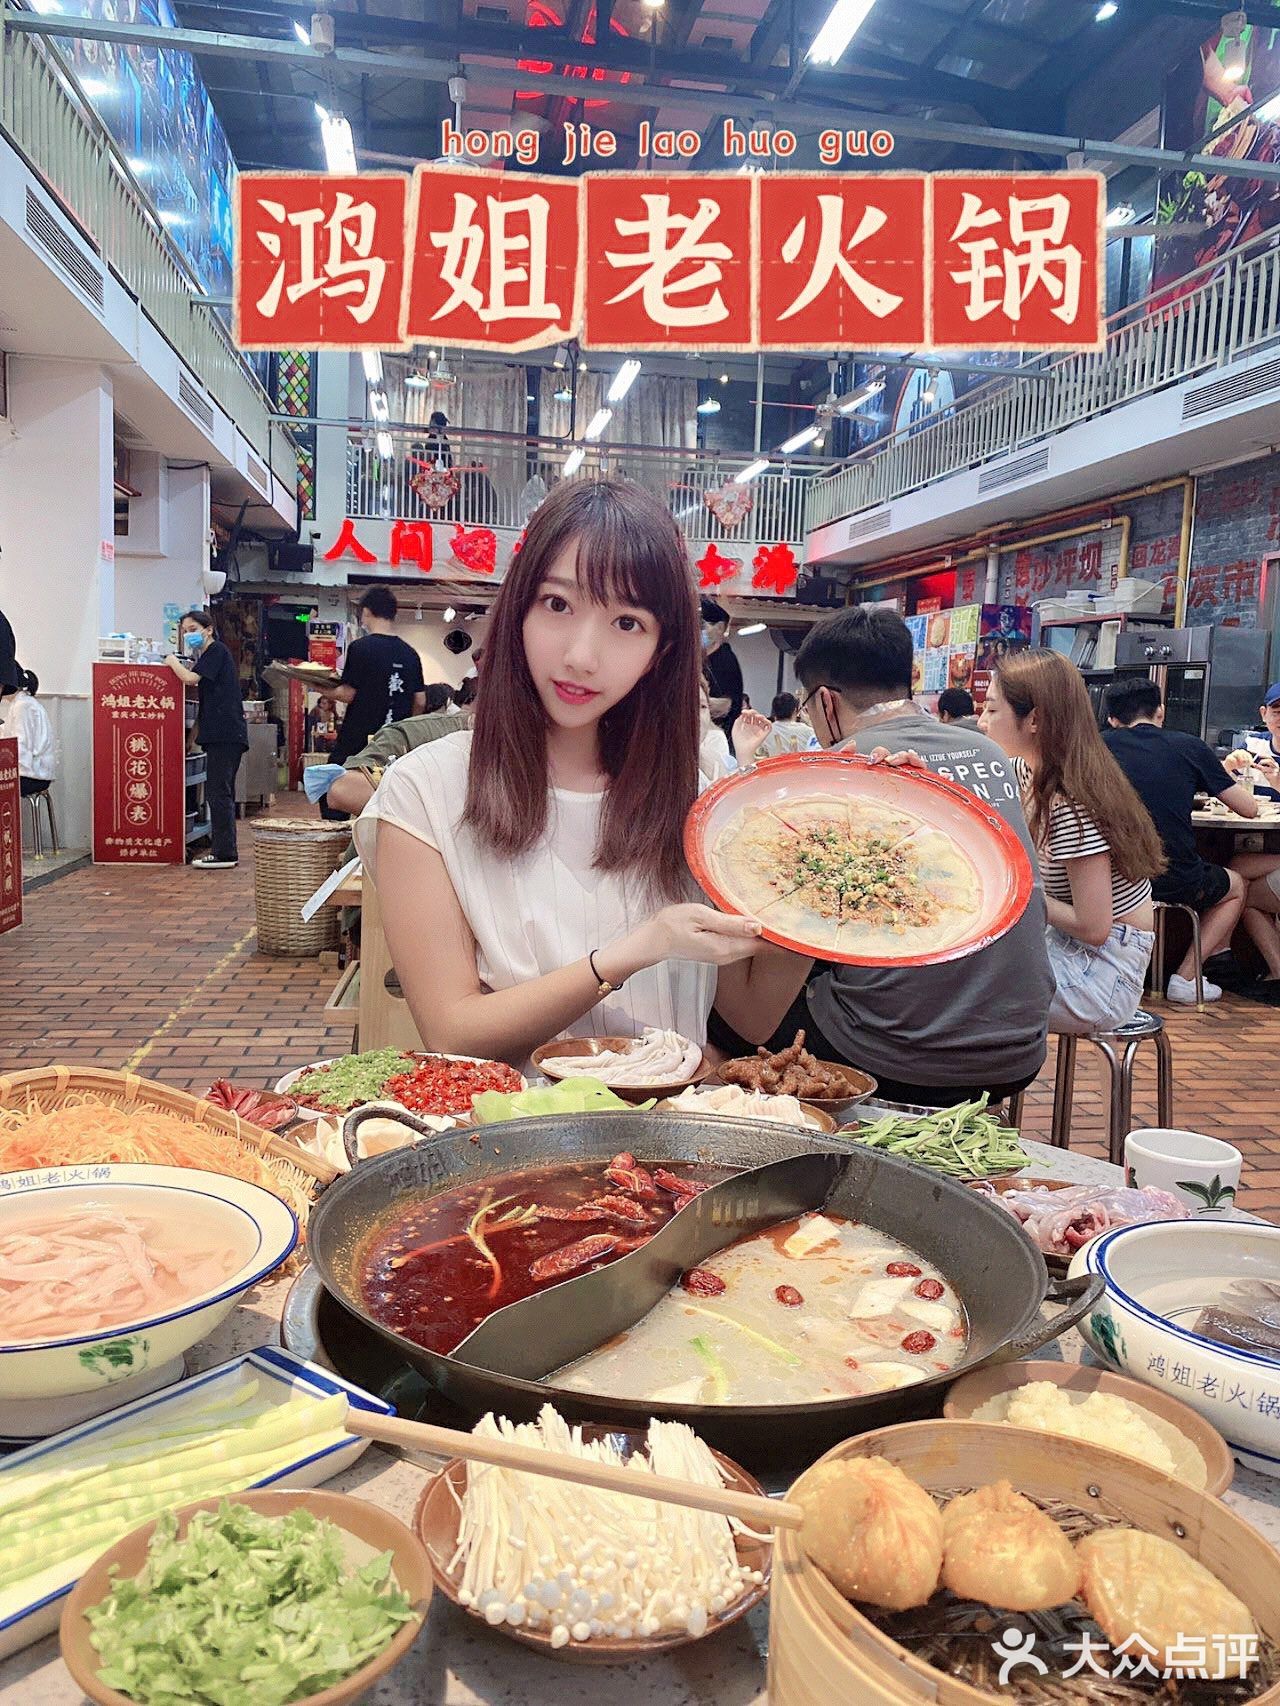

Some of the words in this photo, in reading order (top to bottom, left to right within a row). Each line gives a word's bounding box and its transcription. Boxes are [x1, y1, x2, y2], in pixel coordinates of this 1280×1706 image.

[101, 693, 176, 711] 鸿姐老火锅
[129, 736, 150, 822] 桃花爆表
[937, 761, 1006, 782] SPEC
